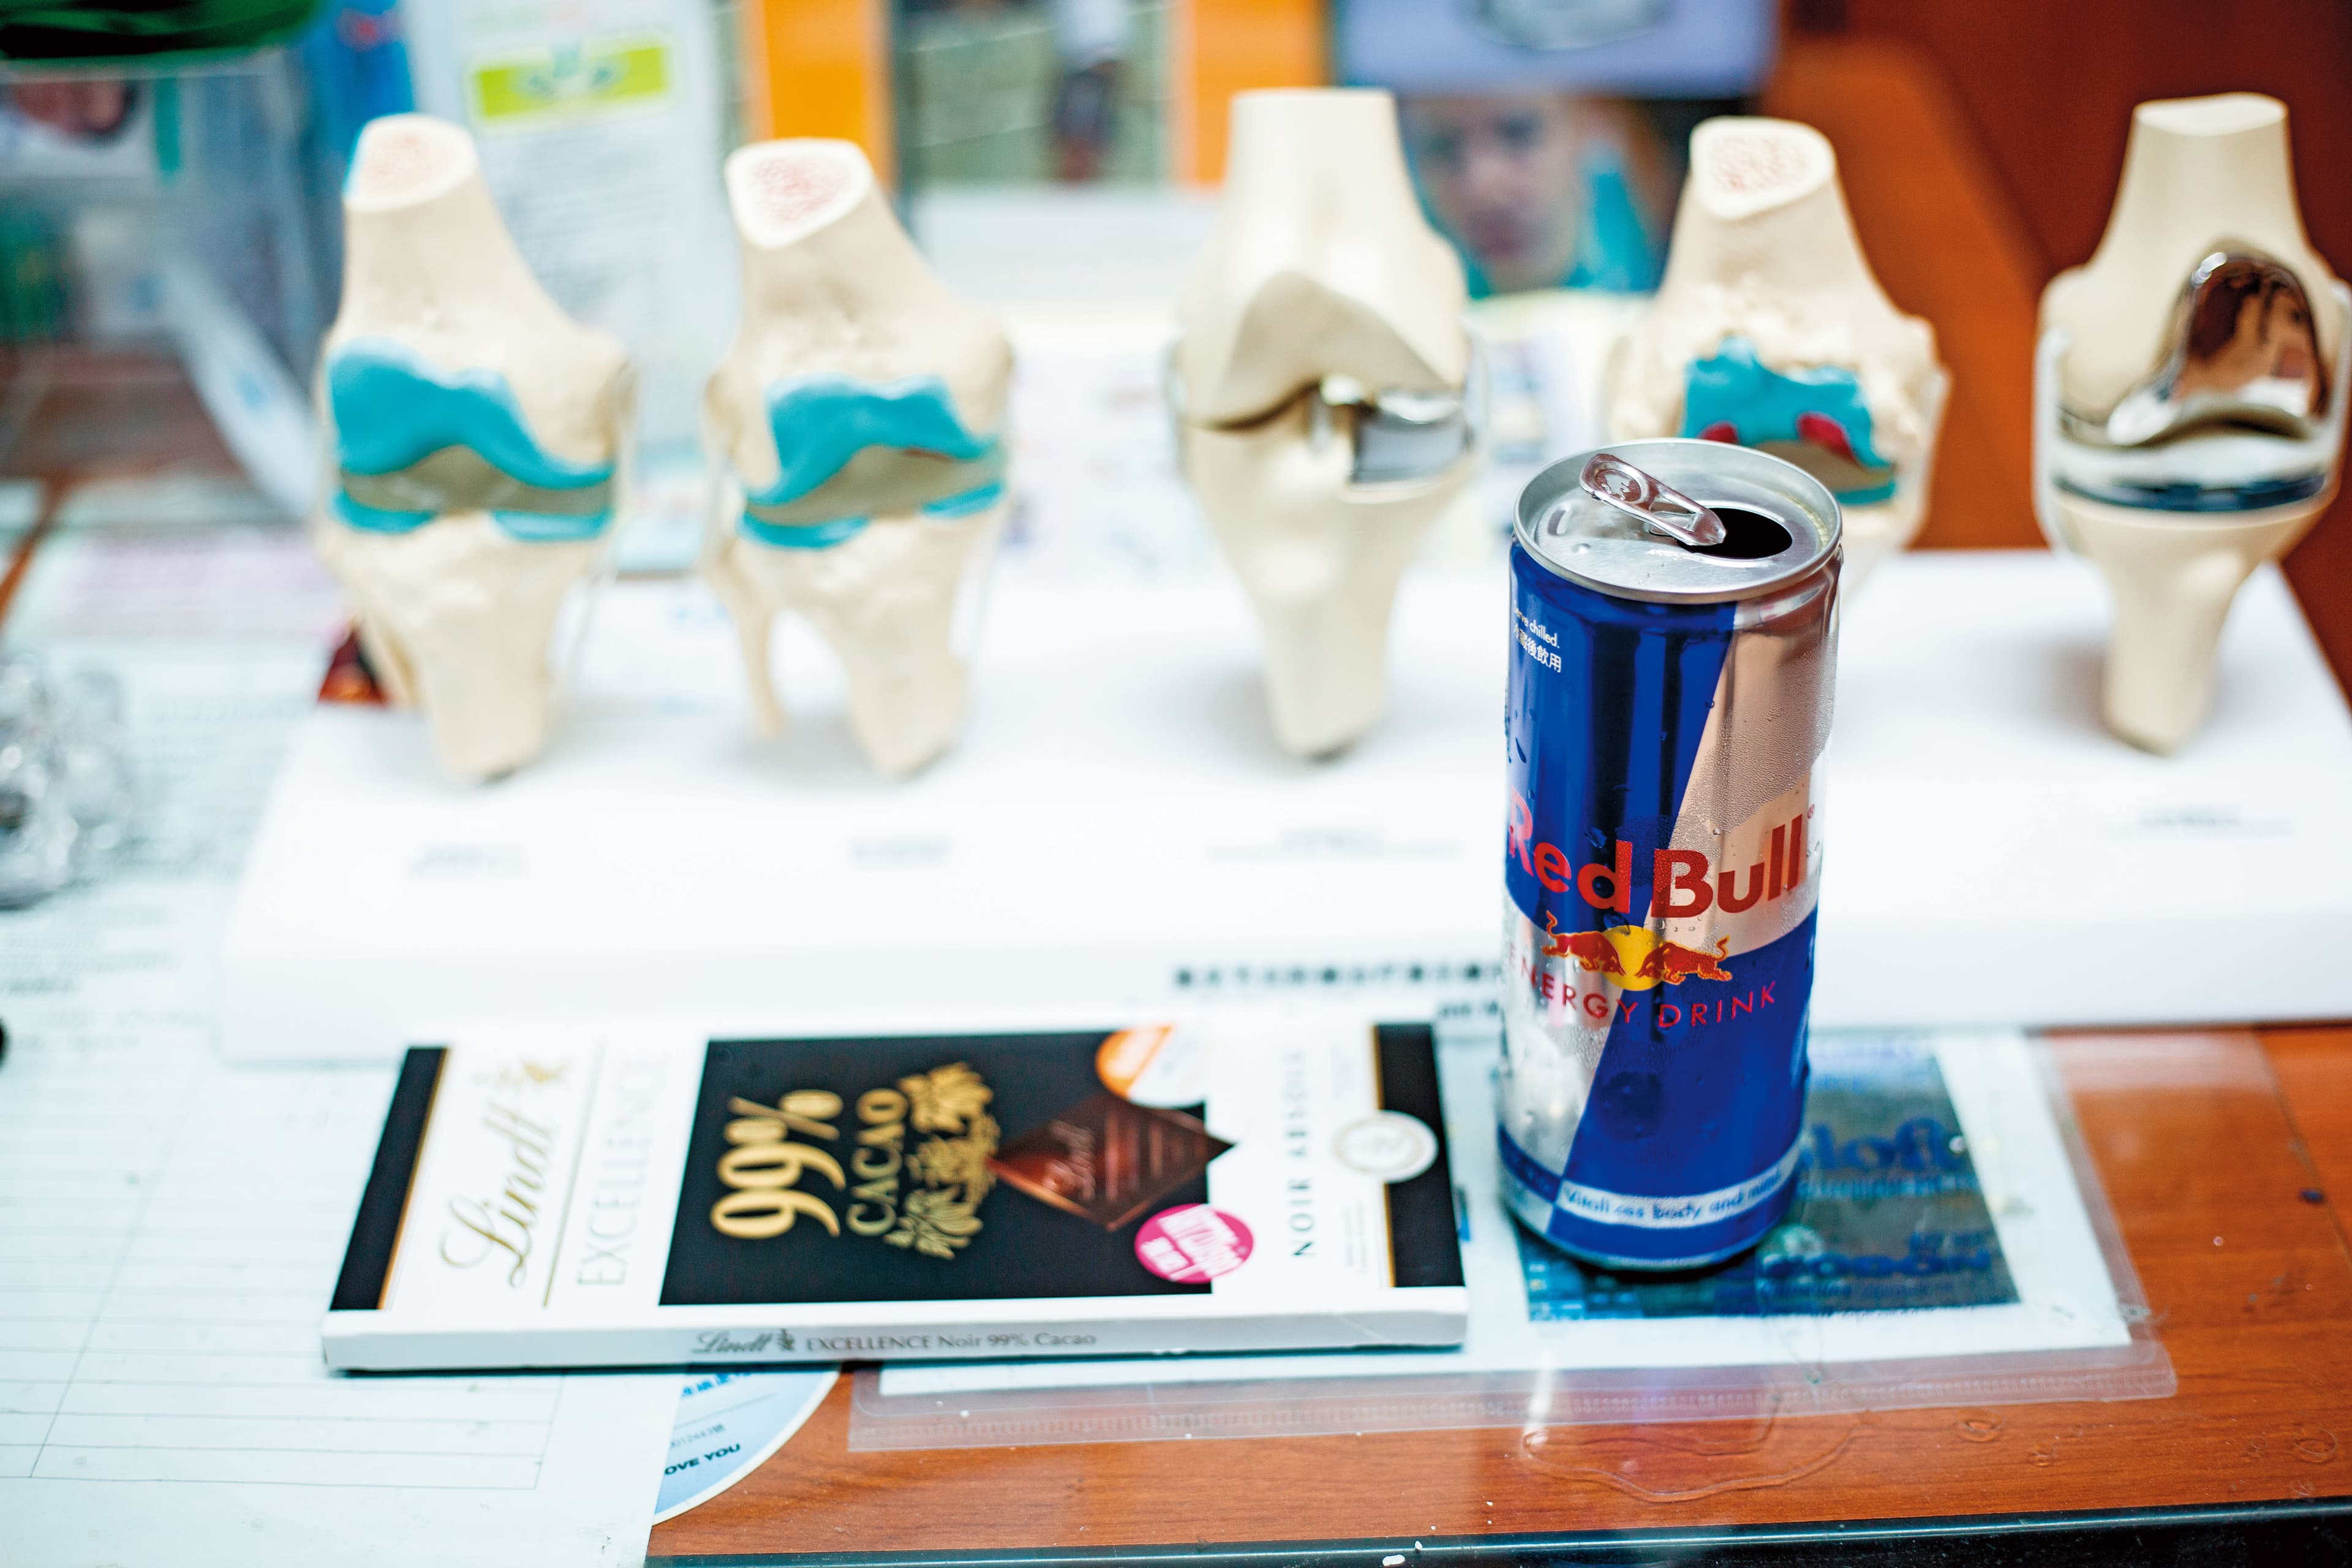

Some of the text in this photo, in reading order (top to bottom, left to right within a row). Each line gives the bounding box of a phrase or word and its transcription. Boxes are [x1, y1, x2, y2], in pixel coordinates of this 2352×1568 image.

[1529, 619, 1560, 649] chilled.
[1509, 788, 1803, 919] Red Bull
[1508, 943, 1776, 1029] ENERGY DRINK
[710, 1088, 846, 1240] 99%
[845, 1088, 910, 1236] CACAO
[1709, 1186, 1743, 1213] and
[692, 1330, 1097, 1354] Lindt EXCELLENCE Noir 99% Cacao
[664, 1443, 741, 1476] OVE YOU
